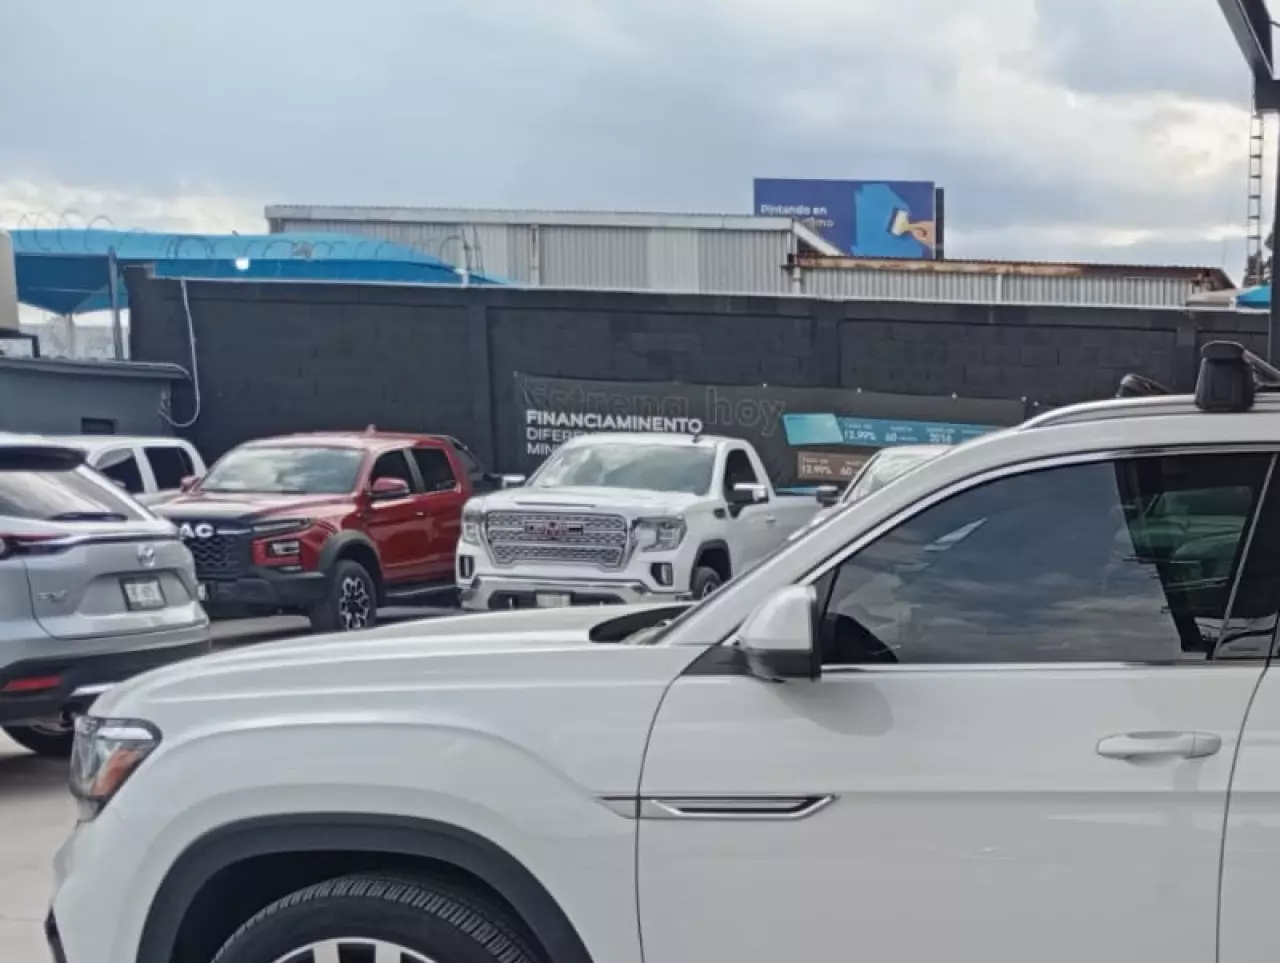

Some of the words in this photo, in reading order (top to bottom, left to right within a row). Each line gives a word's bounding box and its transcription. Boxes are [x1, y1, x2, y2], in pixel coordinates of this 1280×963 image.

[526, 408, 703, 434] FINANCIAMINENTO
[706, 386, 785, 438] hoy
[179, 522, 214, 539] AC
